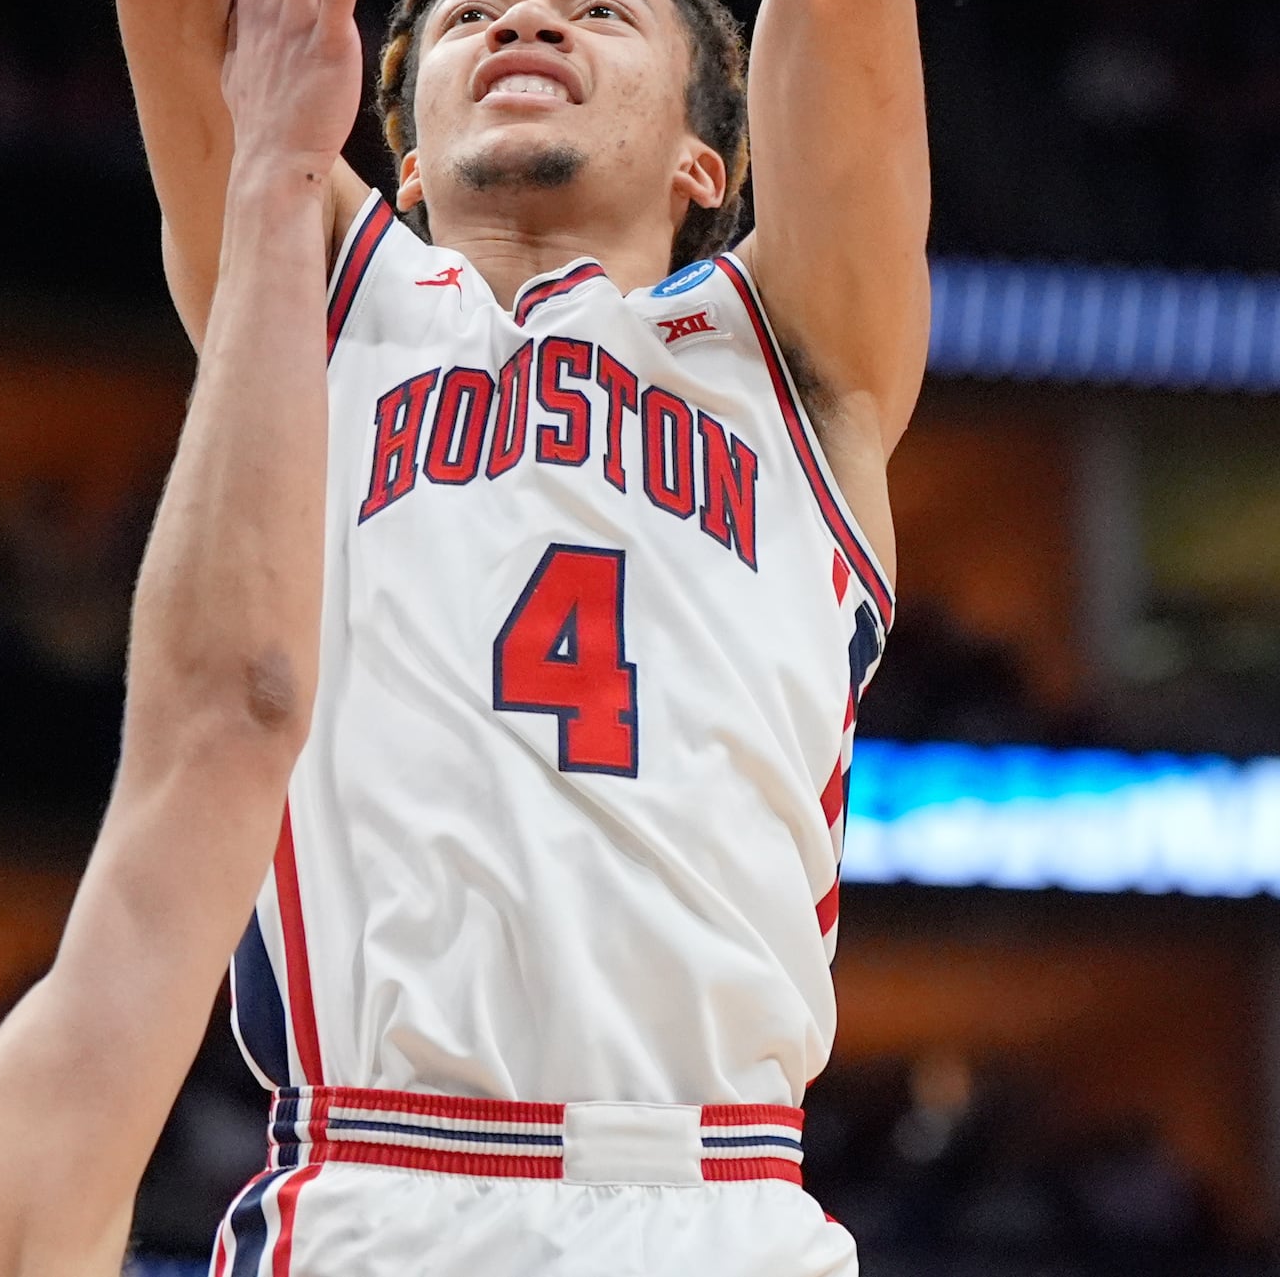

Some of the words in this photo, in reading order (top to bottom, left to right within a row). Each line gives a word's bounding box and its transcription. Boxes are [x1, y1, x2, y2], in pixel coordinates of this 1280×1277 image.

[656, 311, 717, 343] XII
[658, 260, 712, 294] NCAA
[357, 336, 758, 573] HOUSTON
[493, 543, 639, 779] 4
